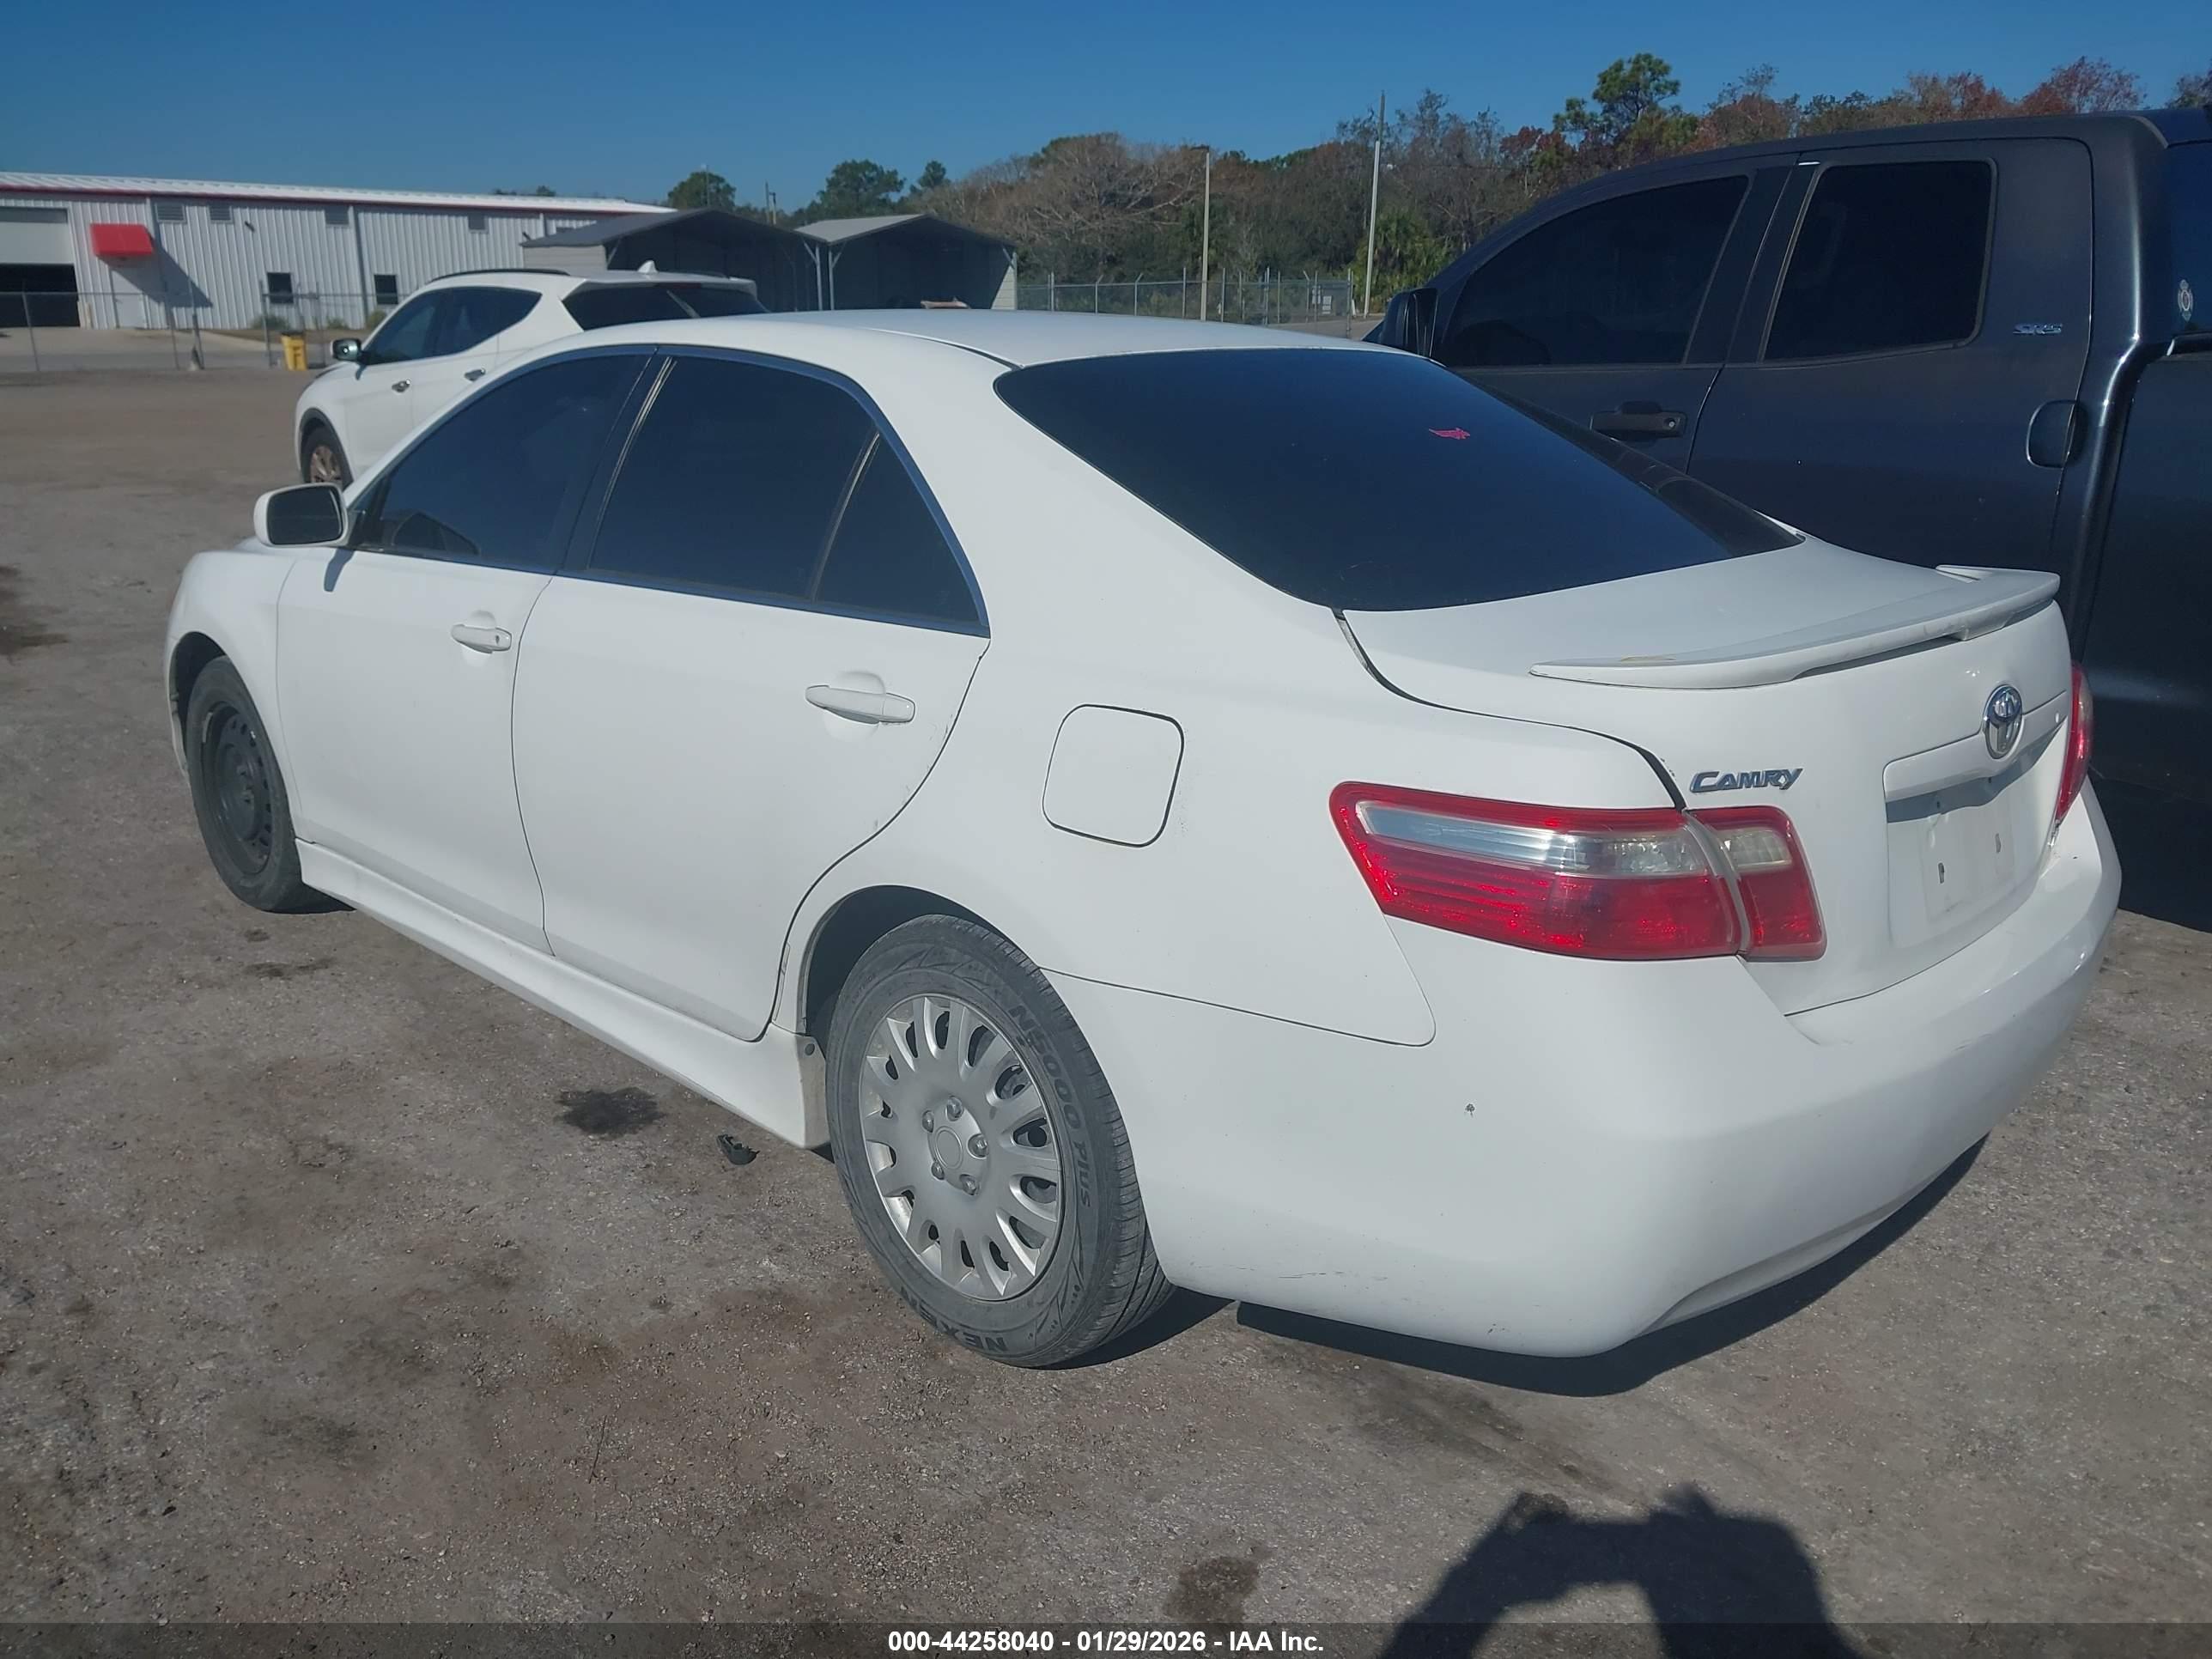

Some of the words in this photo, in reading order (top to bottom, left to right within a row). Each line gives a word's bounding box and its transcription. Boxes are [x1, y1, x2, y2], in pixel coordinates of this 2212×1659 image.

[1690, 768, 1803, 793] CAMRY
[1007, 1004, 1081, 1130] N5000
[901, 1287, 1009, 1352] NEXEN
